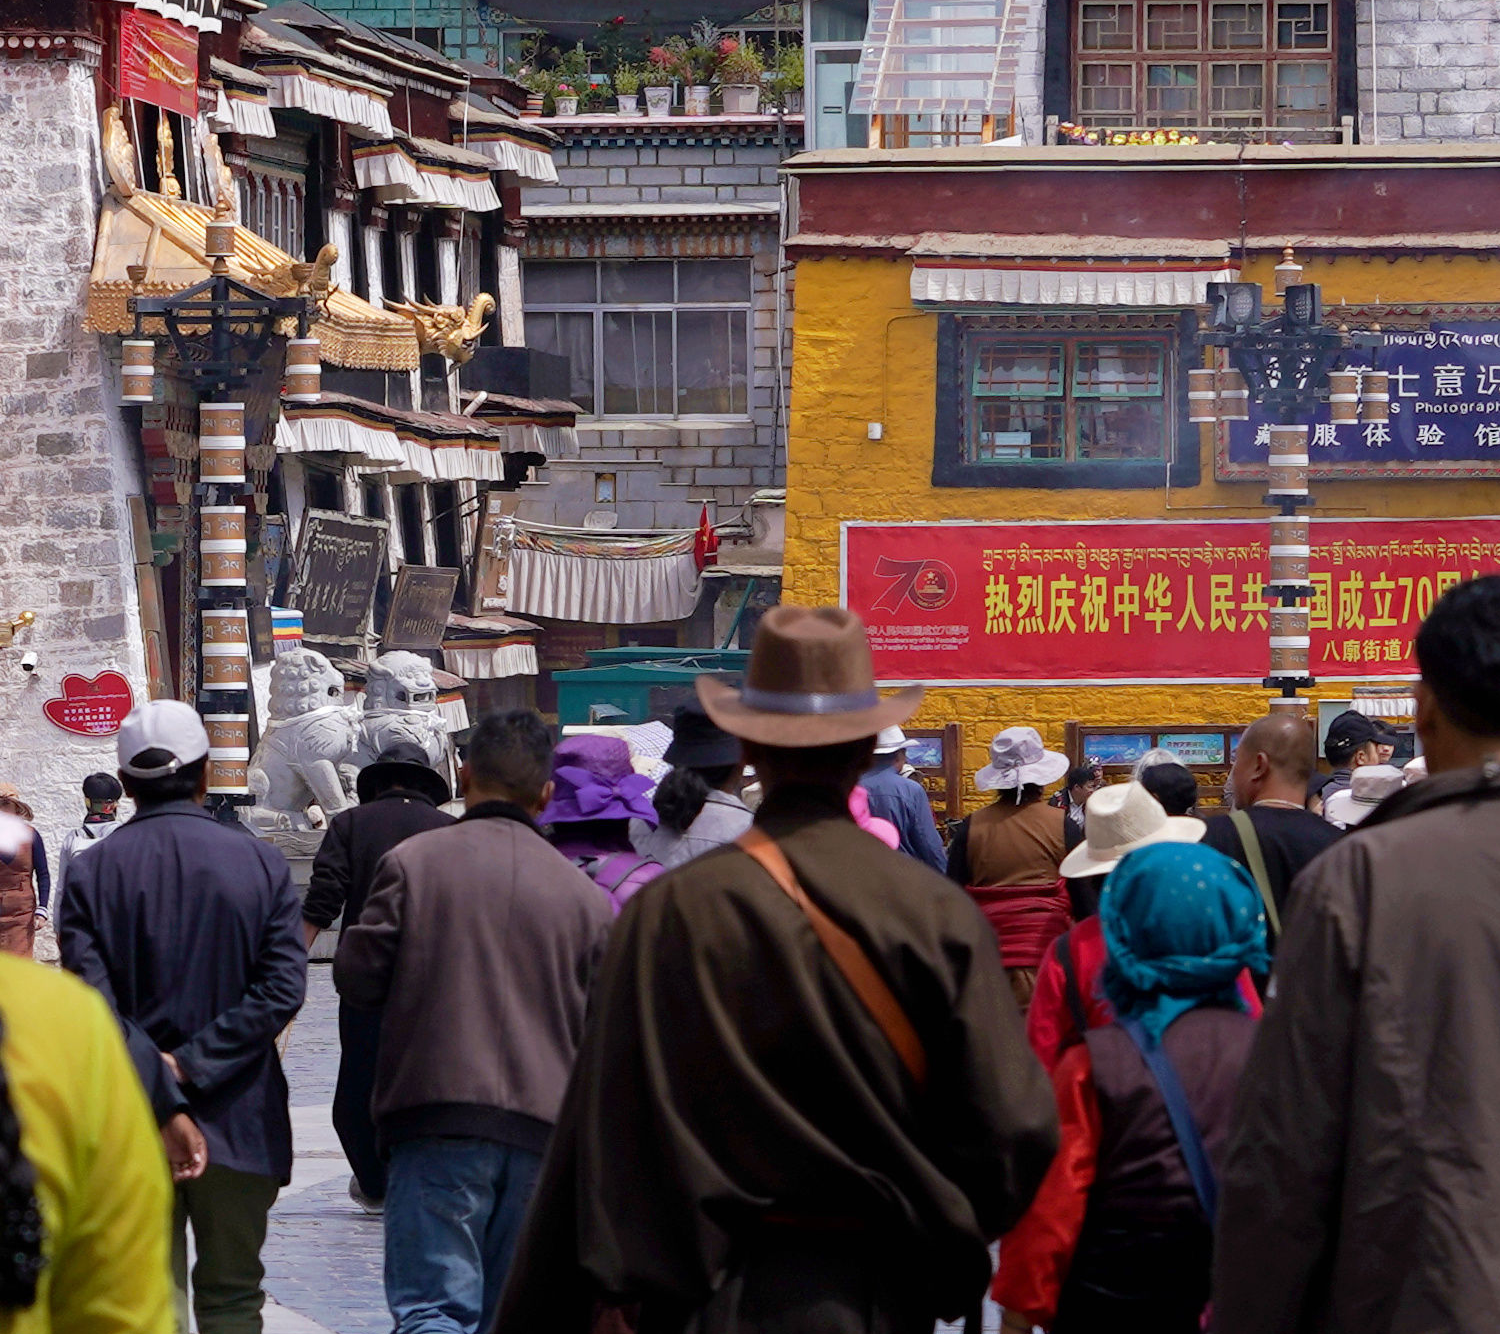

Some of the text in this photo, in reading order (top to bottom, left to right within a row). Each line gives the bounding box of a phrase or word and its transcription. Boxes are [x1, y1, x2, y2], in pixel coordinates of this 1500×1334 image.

[984, 570, 1481, 635] 热烈庆祝中华人民共国成立70
